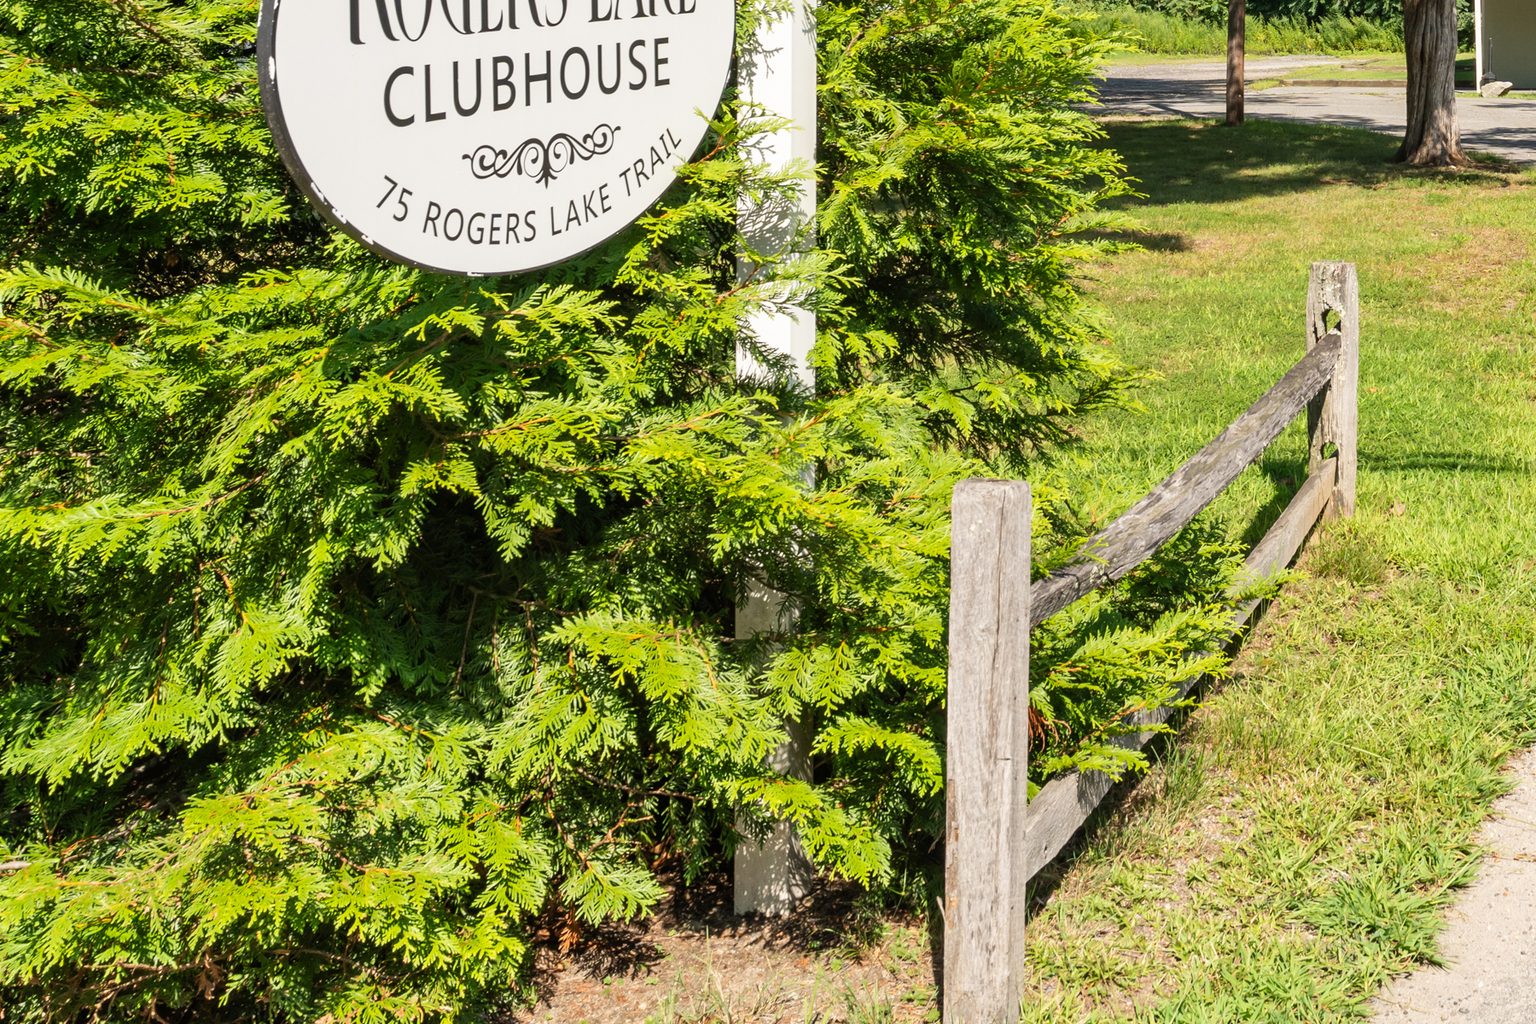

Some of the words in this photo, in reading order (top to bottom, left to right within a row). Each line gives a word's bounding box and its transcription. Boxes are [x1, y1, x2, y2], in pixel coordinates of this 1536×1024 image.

[383, 36, 671, 128] CLUBHOUSE
[375, 175, 414, 223] 75
[422, 199, 537, 246] ROGERS
[550, 183, 613, 237] LAKE
[618, 126, 683, 198] TRAIL
